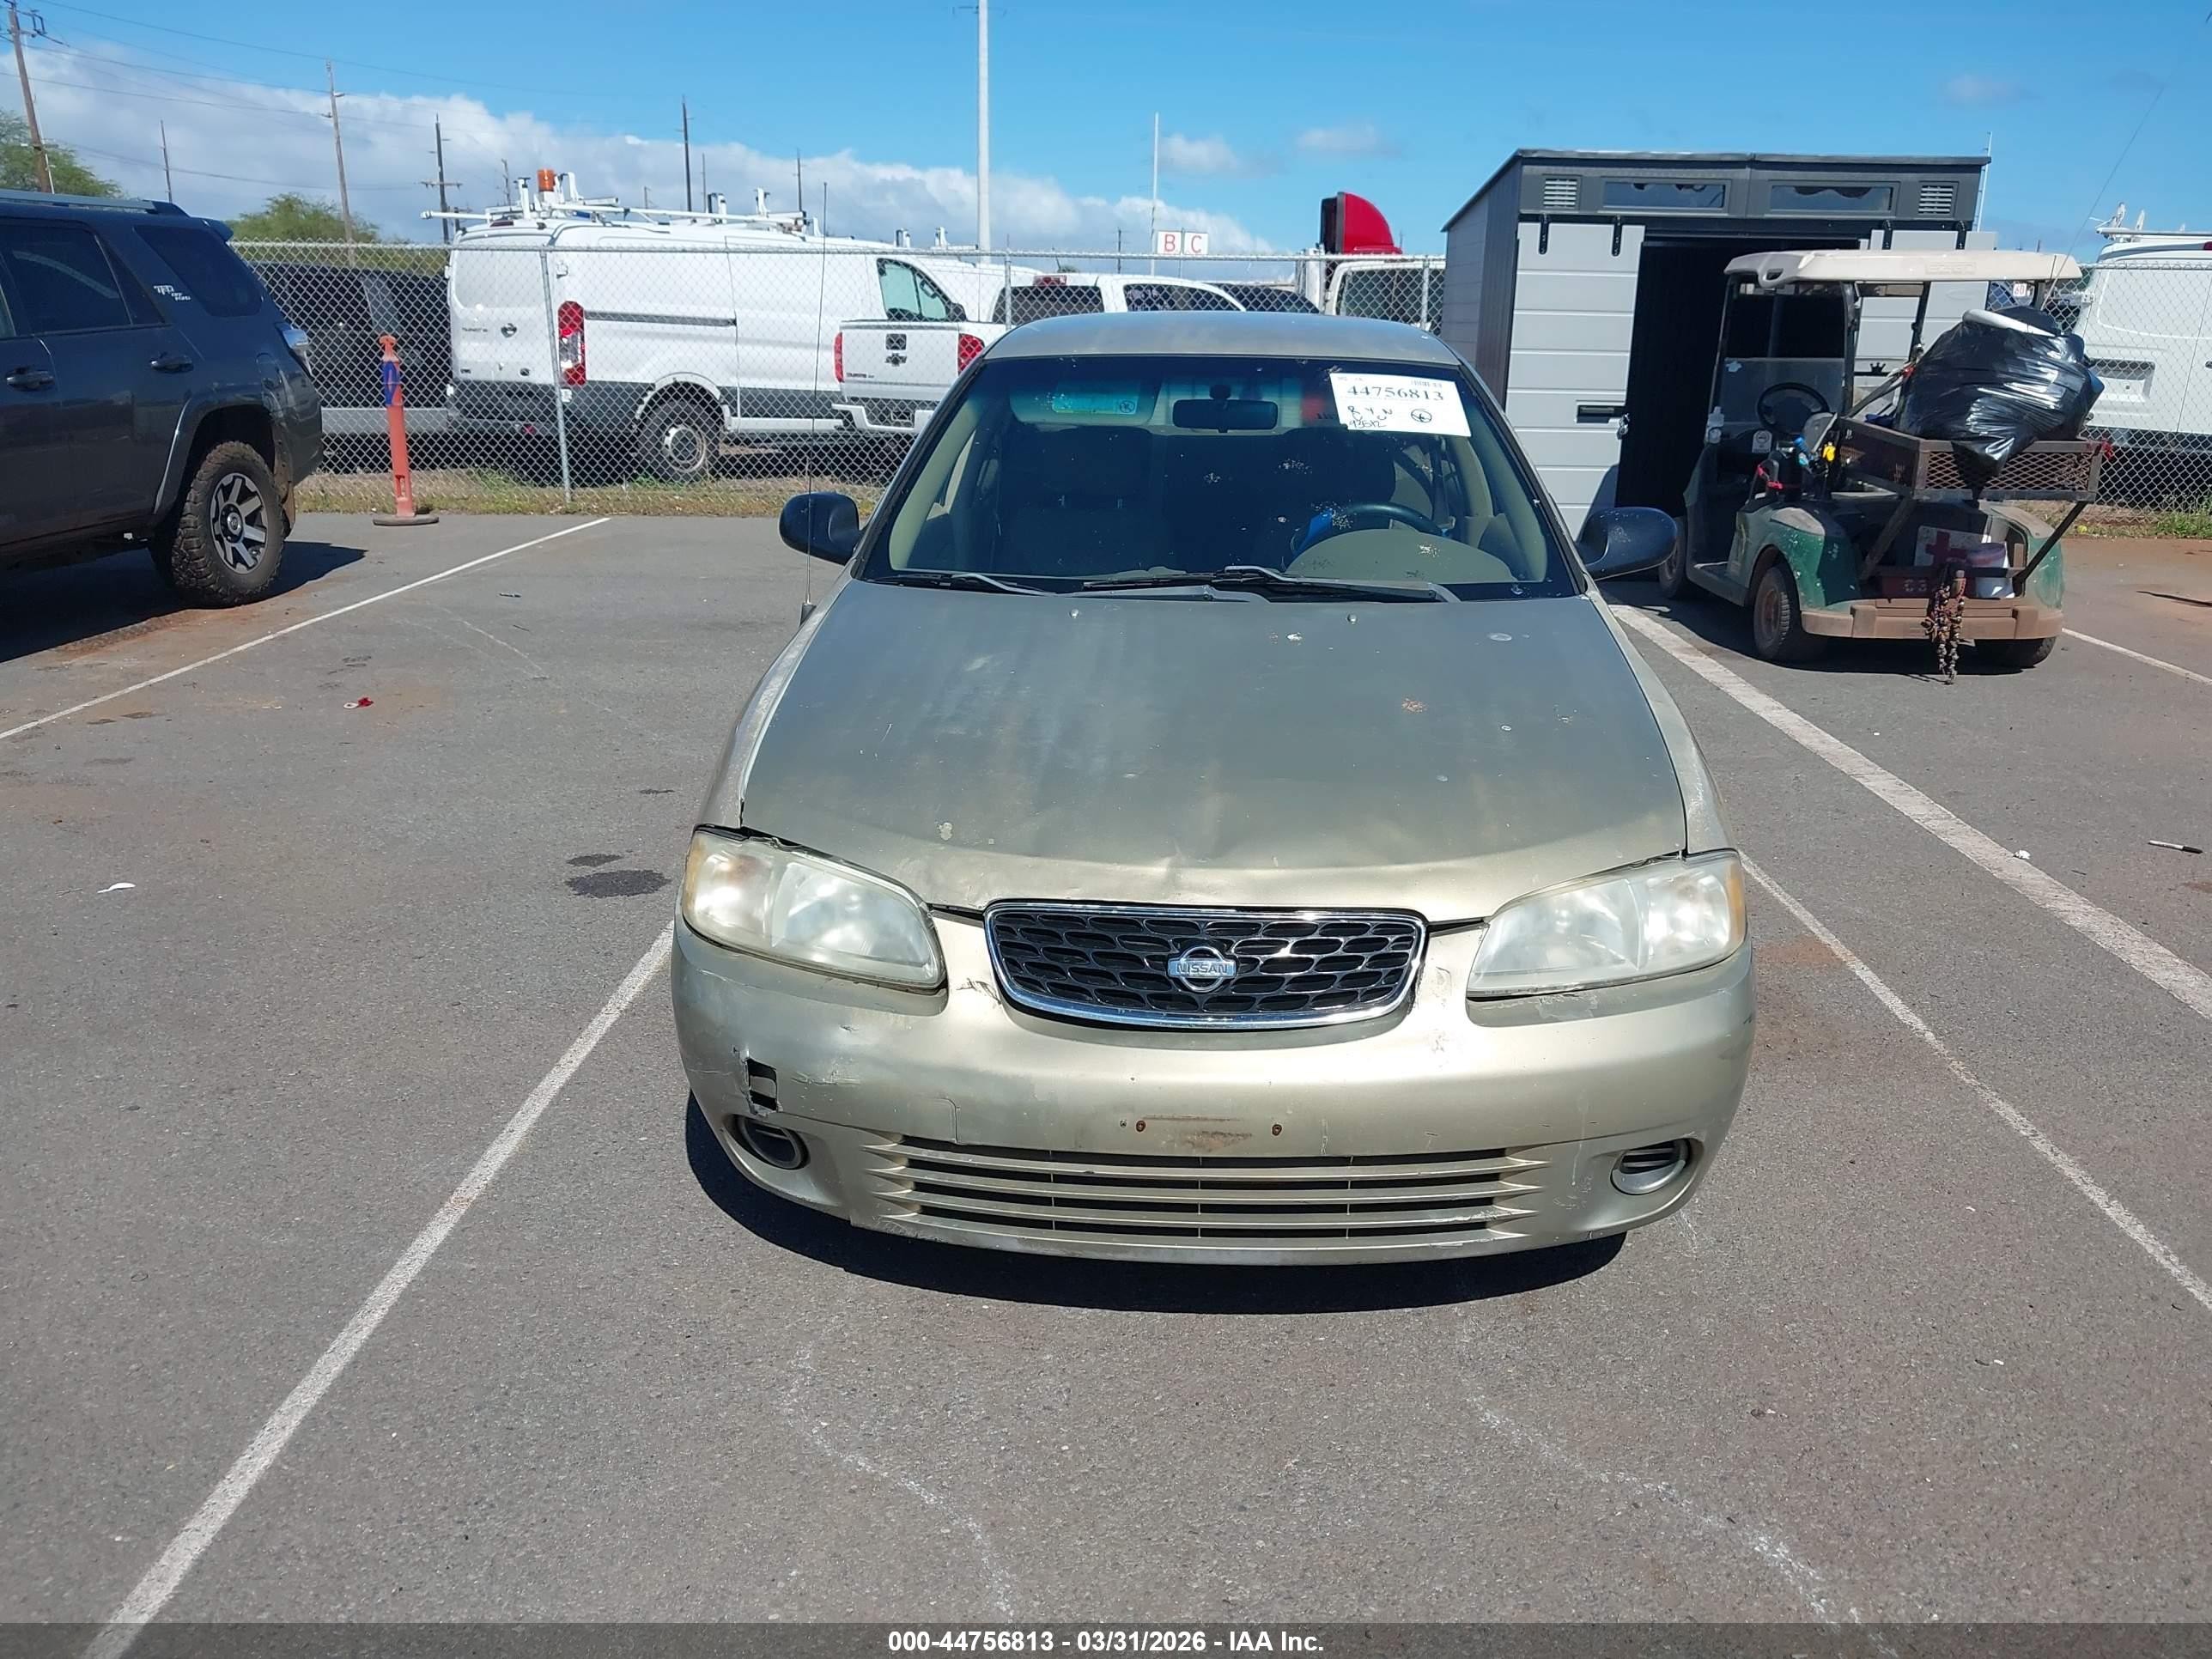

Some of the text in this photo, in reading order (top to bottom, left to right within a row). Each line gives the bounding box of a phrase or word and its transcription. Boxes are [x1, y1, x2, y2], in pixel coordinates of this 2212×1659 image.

[1164, 234, 1176, 252] B
[1190, 234, 1203, 253] C
[1347, 385, 1444, 401] 44756813
[1176, 963, 1228, 974] NISSAN
